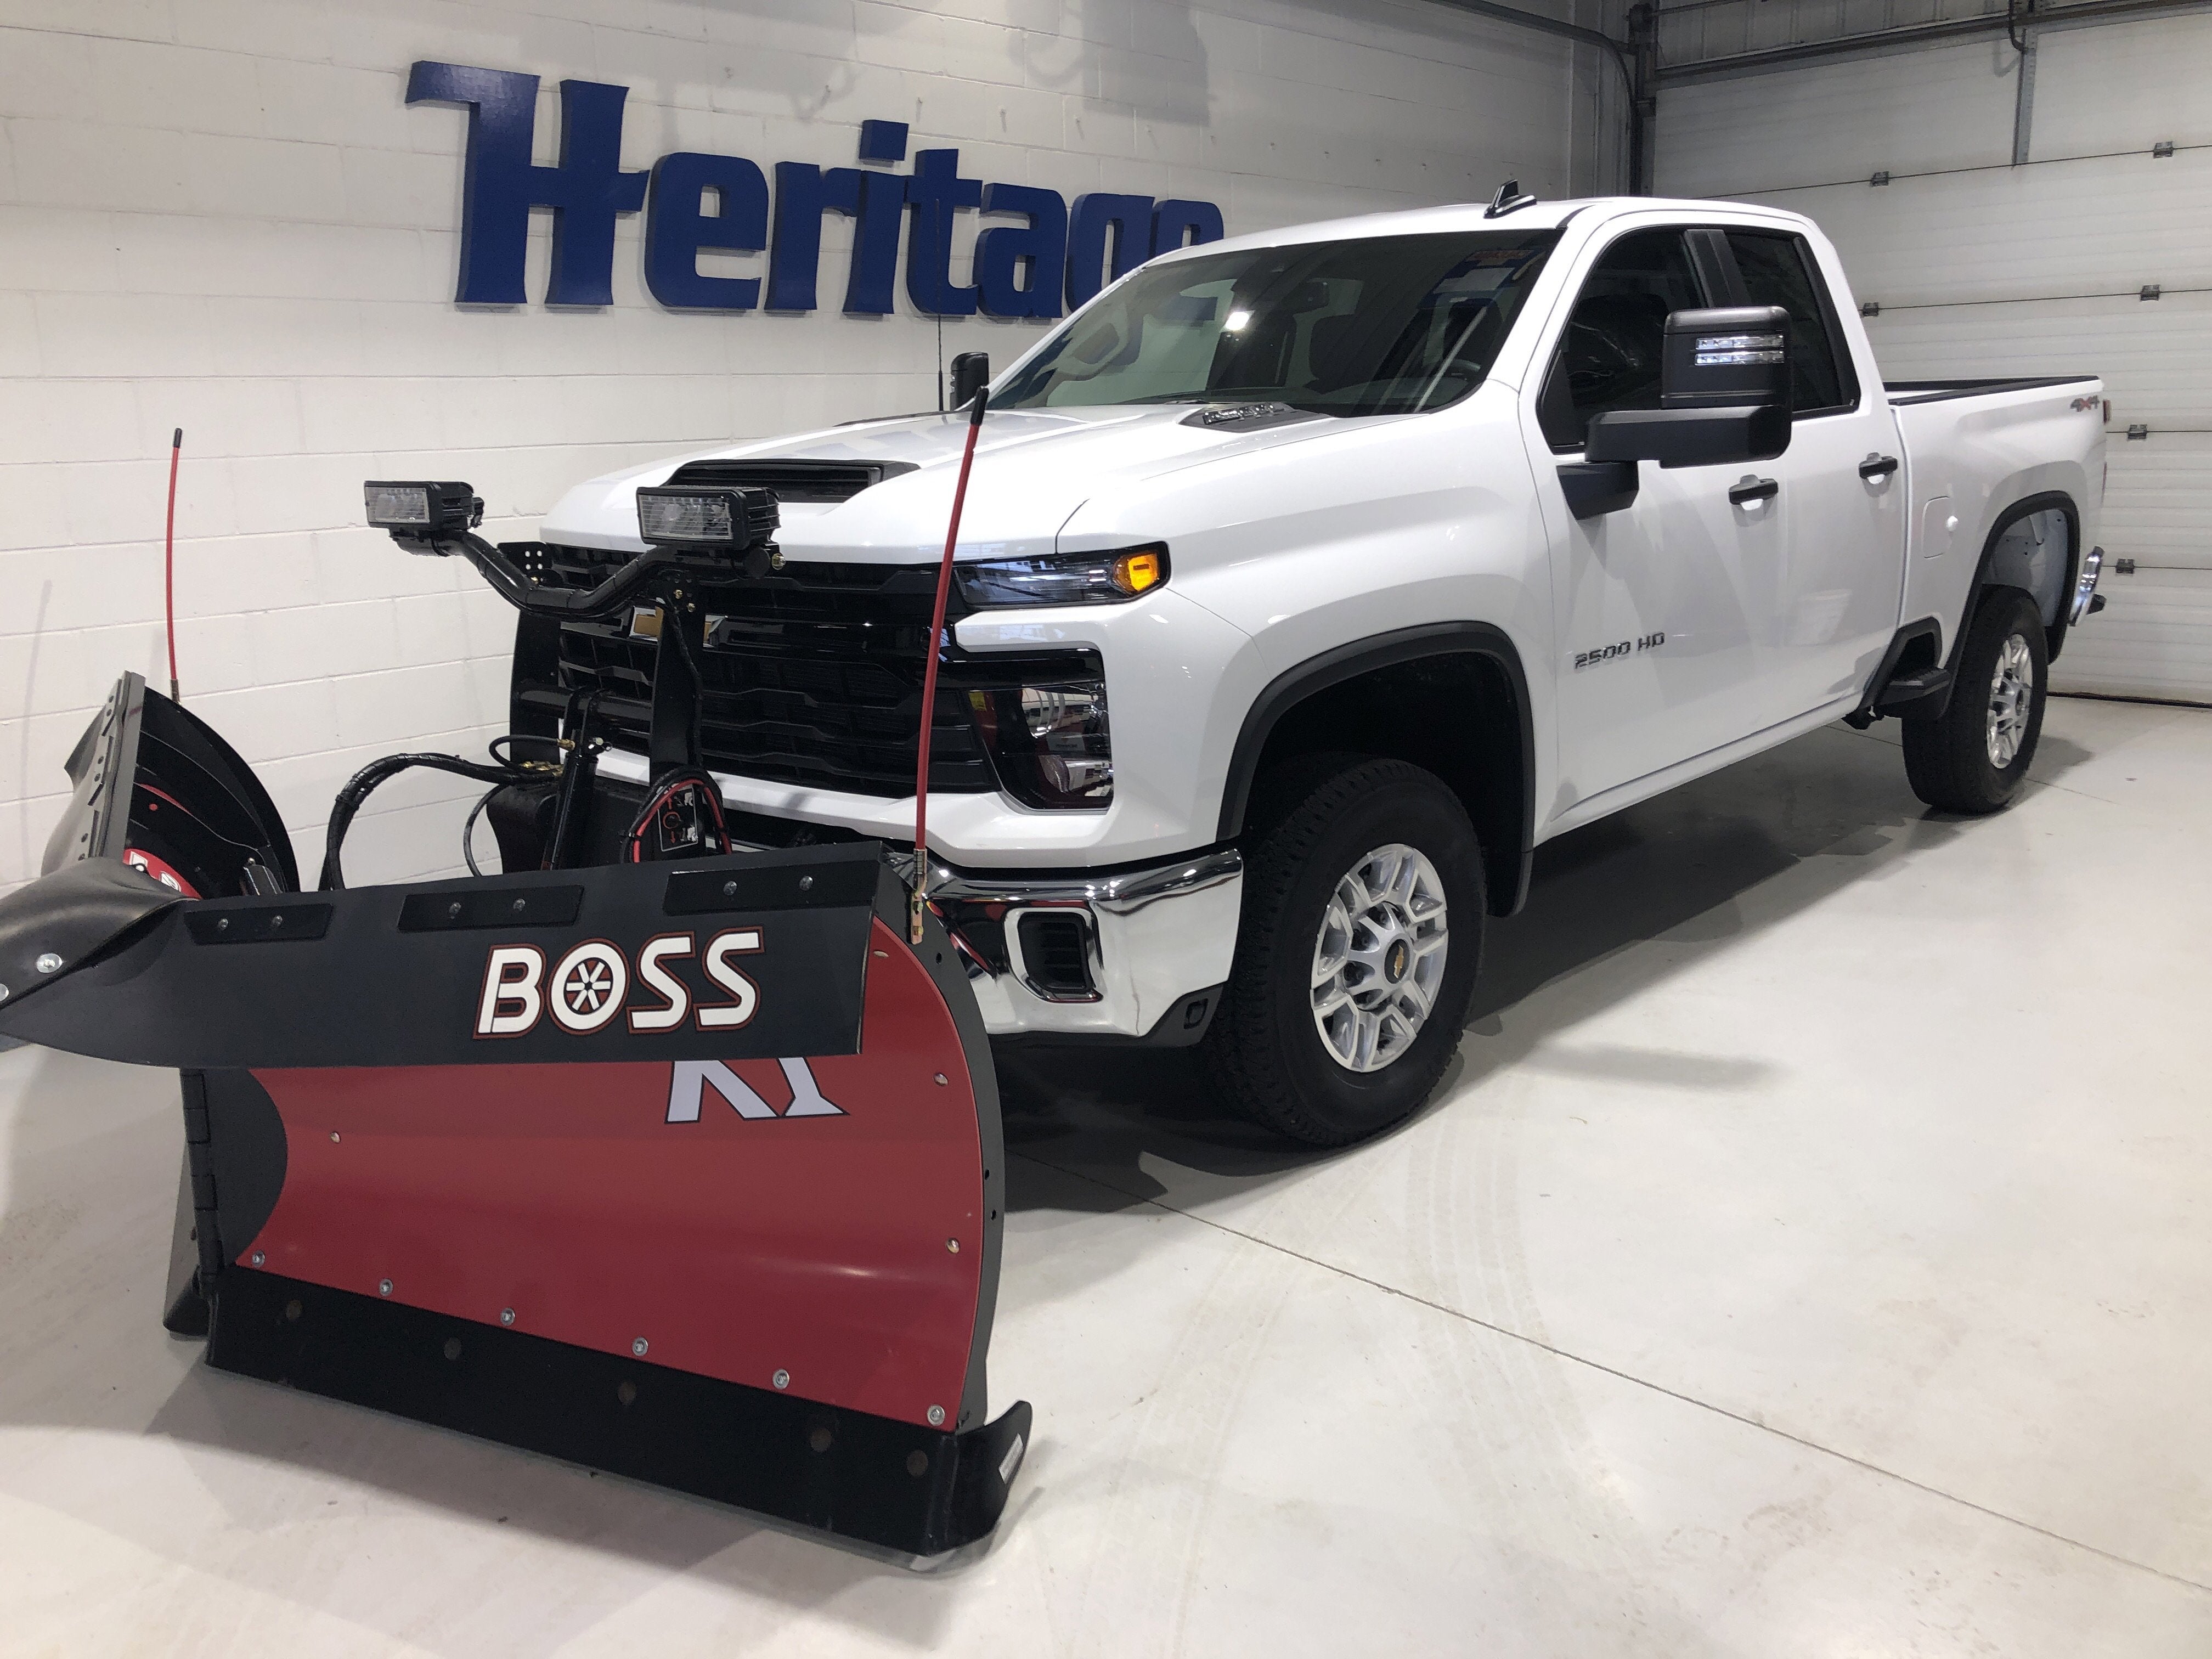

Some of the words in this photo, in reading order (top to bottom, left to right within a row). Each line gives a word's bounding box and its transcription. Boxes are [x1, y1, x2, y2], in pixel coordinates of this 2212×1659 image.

[1573, 641, 1631, 669] 2500
[1637, 631, 1665, 652] HD
[473, 926, 765, 1039] BOSS
